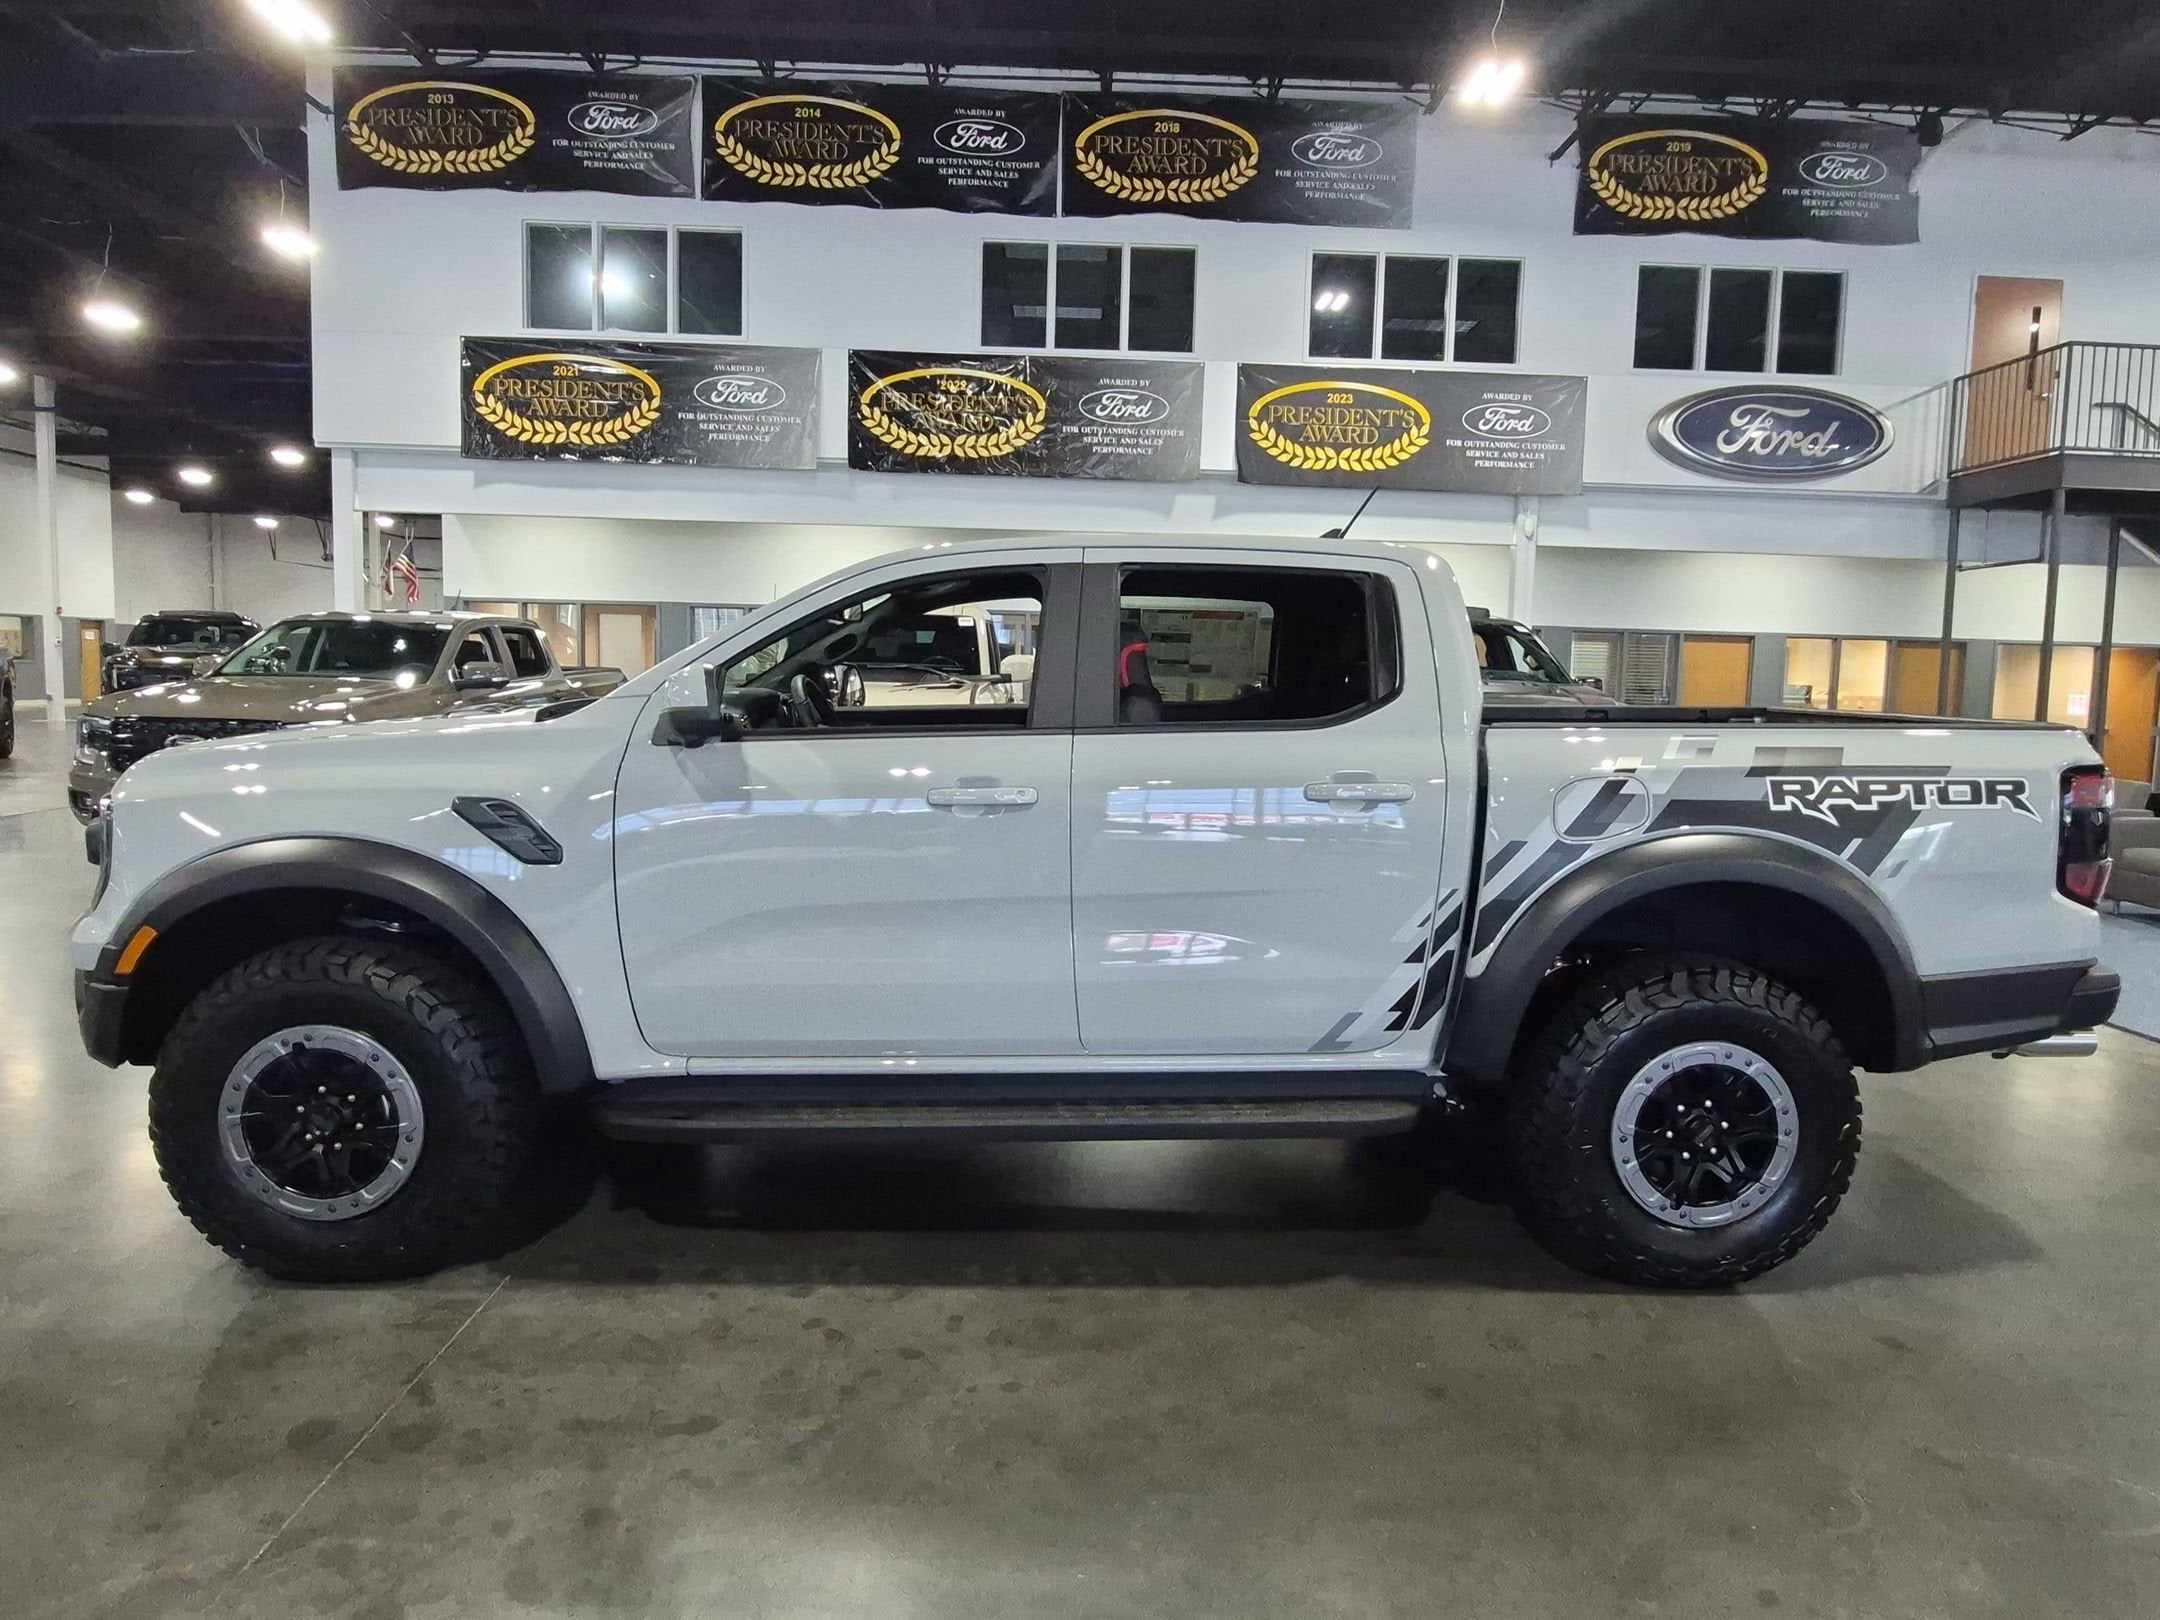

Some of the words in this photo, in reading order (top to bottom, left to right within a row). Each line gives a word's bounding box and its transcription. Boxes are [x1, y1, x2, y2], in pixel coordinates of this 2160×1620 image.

[588, 91, 626, 100] AWARDED
[629, 92, 640, 100] BY
[367, 107, 520, 128] PRESIDENT'S
[584, 105, 640, 130] Ford
[794, 107, 821, 118] 2014
[954, 108, 993, 116] AWARDED
[995, 109, 1006, 118] BY
[735, 119, 885, 144] PRESIDENT'S
[1154, 122, 1181, 133] 2018
[403, 126, 483, 146] AWARD
[951, 123, 1008, 149] Ford
[552, 139, 569, 147] FOR
[571, 139, 628, 149] OUTSTANDING
[629, 142, 675, 150] CUSTOMER
[770, 139, 848, 160] AWARD
[1095, 135, 1244, 158] PRESIDENT'S
[1308, 136, 1366, 162] Ford
[573, 150, 609, 159] SERVICE
[612, 151, 628, 160] AND
[628, 152, 654, 160] SALES
[583, 160, 646, 170] PERFORMANCE
[918, 157, 934, 165] FOR
[936, 157, 994, 167] OUTSTANDING
[995, 160, 1040, 169] CUSTOMER
[1126, 155, 1208, 175] AWARD
[1608, 154, 1753, 176] PRESIDENT'S
[1815, 155, 1870, 180] Ford
[938, 168, 973, 176] SERVICE
[976, 169, 992, 177] AND
[994, 170, 1019, 179] SALES
[948, 178, 1009, 188] PERFORMANCE
[1638, 173, 1718, 193] AWARD
[1782, 188, 1799, 196] FOR
[553, 365, 579, 377] 2021
[713, 364, 753, 373] AWARDED
[755, 365, 765, 373] BY
[1099, 378, 1138, 386] AWARDED
[1140, 379, 1151, 387] BY
[493, 378, 645, 401] PRESIDENT'S
[711, 380, 768, 404] Ford
[1327, 393, 1354, 404] 2023
[1482, 392, 1521, 401] AWARDED
[527, 397, 609, 417] AWARD
[1095, 393, 1152, 418] Ford
[678, 412, 695, 420] FOR
[697, 412, 754, 422] OUTSTANDING
[757, 416, 801, 425] CUSTOMER
[1268, 405, 1415, 428] PRESIDENT'S
[1478, 407, 1535, 432] Ford
[699, 423, 733, 431] SERVICE
[736, 424, 753, 432] AND
[755, 425, 780, 433] SALES
[1063, 426, 1079, 434] FOR
[1081, 427, 1138, 435] OUTSTANDING
[1140, 428, 1184, 437] CUSTOMER
[1299, 424, 1379, 444] AWARD
[1716, 403, 1841, 458] Ford
[708, 433, 770, 443] PERFORMANCE
[1083, 437, 1117, 445] SERVICE
[1120, 437, 1137, 445] AND
[1139, 437, 1164, 446] SALES
[1446, 439, 1462, 447] FOR
[1464, 440, 1520, 449] OUTSTANDING
[1522, 441, 1566, 450] CUSTOMER
[1093, 446, 1154, 456] PERFORMANCE
[1466, 450, 1499, 459] SERVICE
[1502, 451, 1519, 459] AND
[1520, 452, 1545, 460] SALES
[1474, 460, 1535, 469] PERFORMANCE
[1766, 776, 2043, 827] RAPTOR
